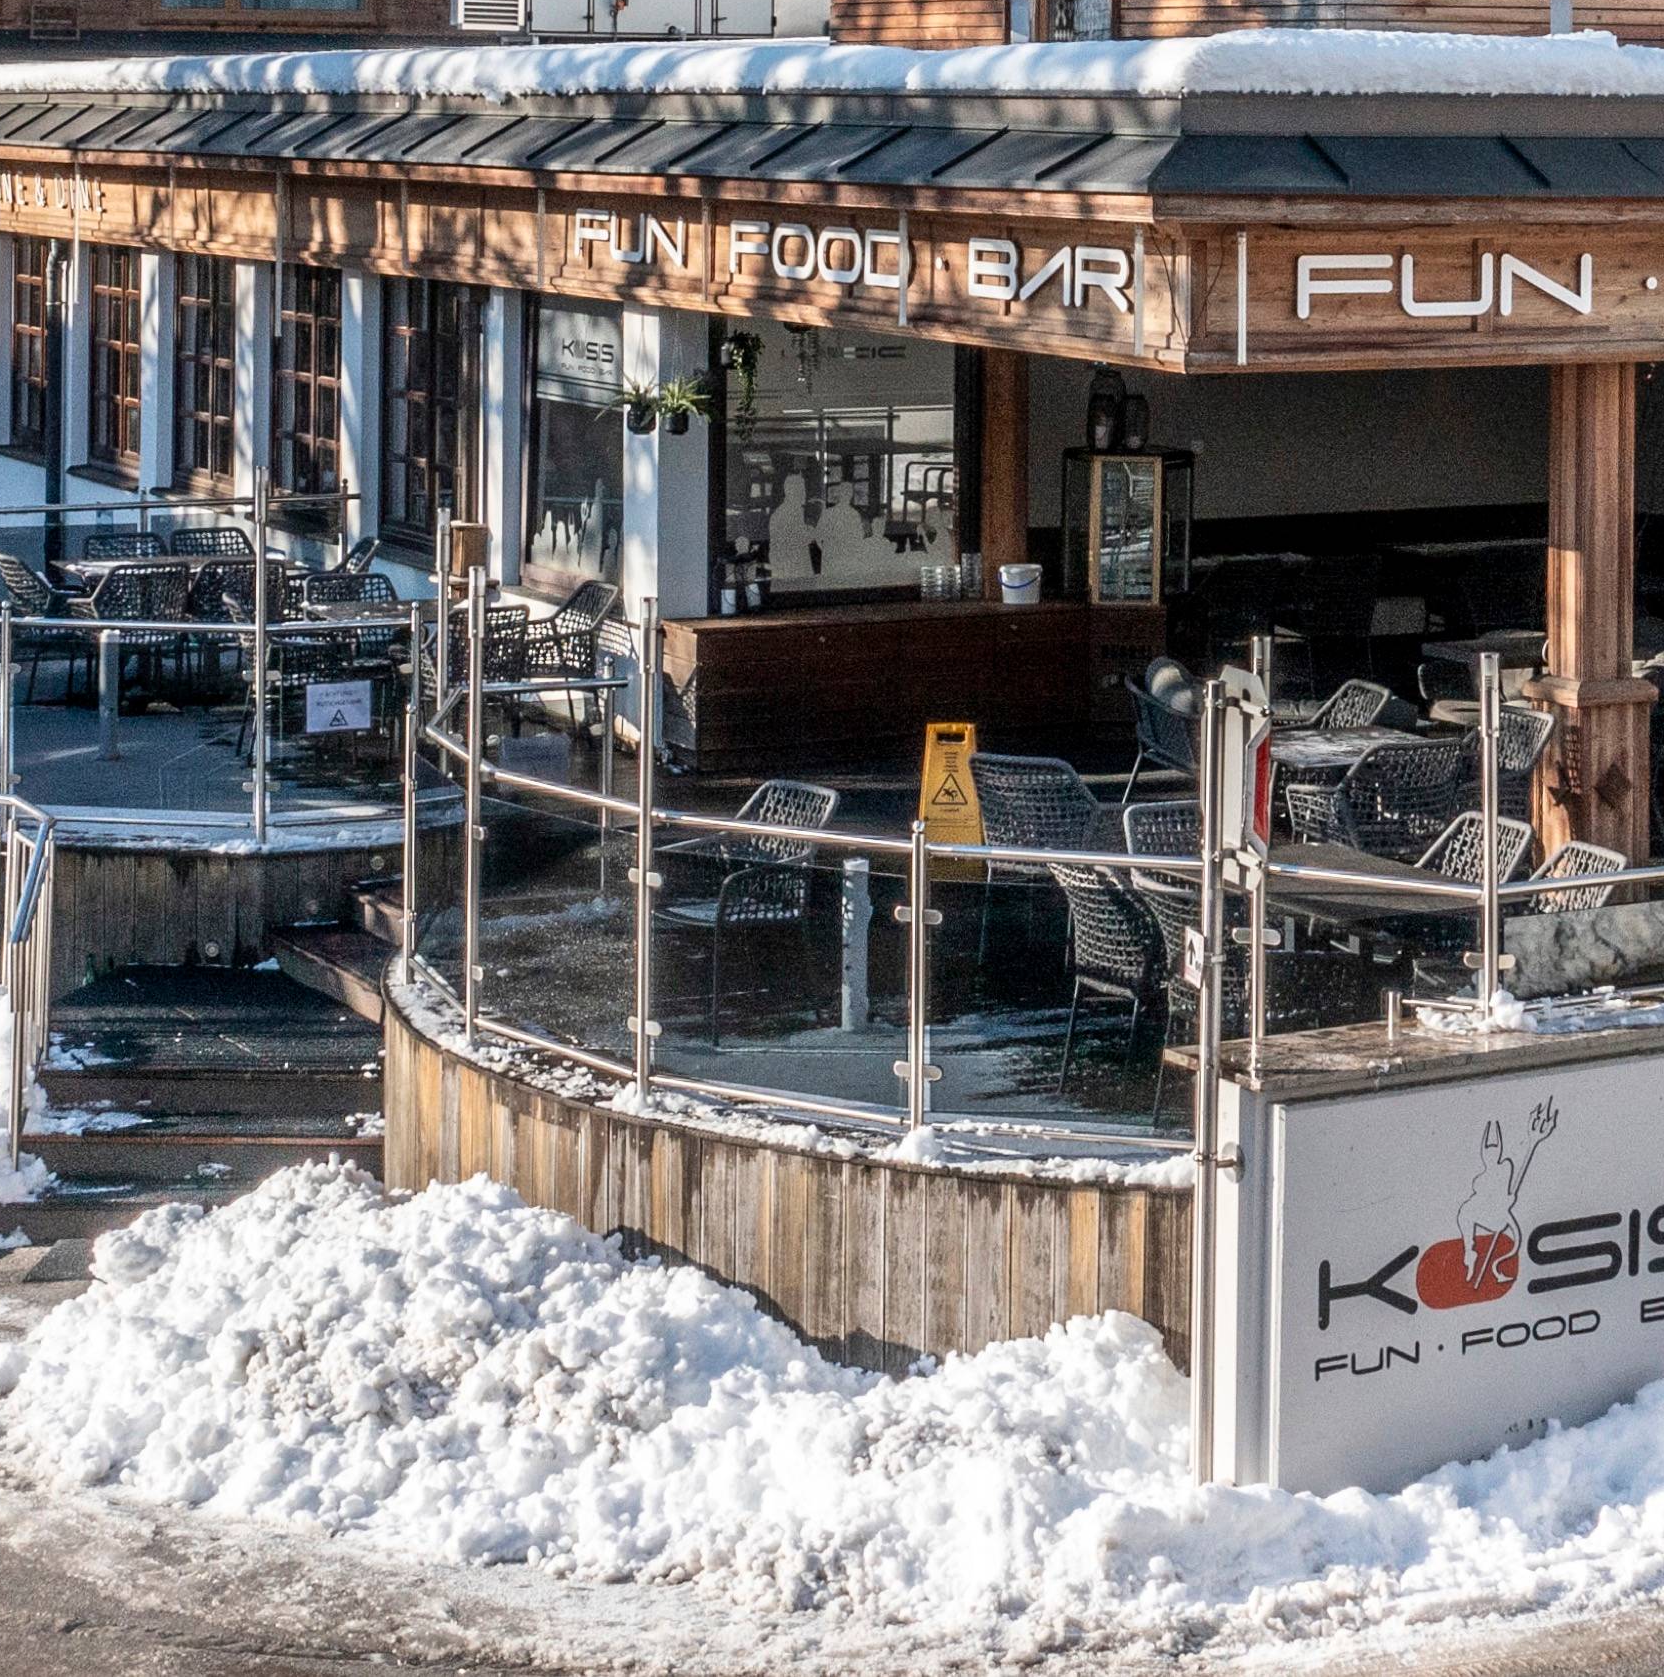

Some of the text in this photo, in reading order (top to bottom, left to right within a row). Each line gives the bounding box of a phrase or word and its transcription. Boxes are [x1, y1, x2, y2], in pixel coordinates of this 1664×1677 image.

[574, 208, 1130, 313] FUN FOOD BAR
[1297, 252, 1592, 319] FUN
[1314, 1341, 1420, 1382] FUN
[1461, 1309, 1601, 1355] FOOD
